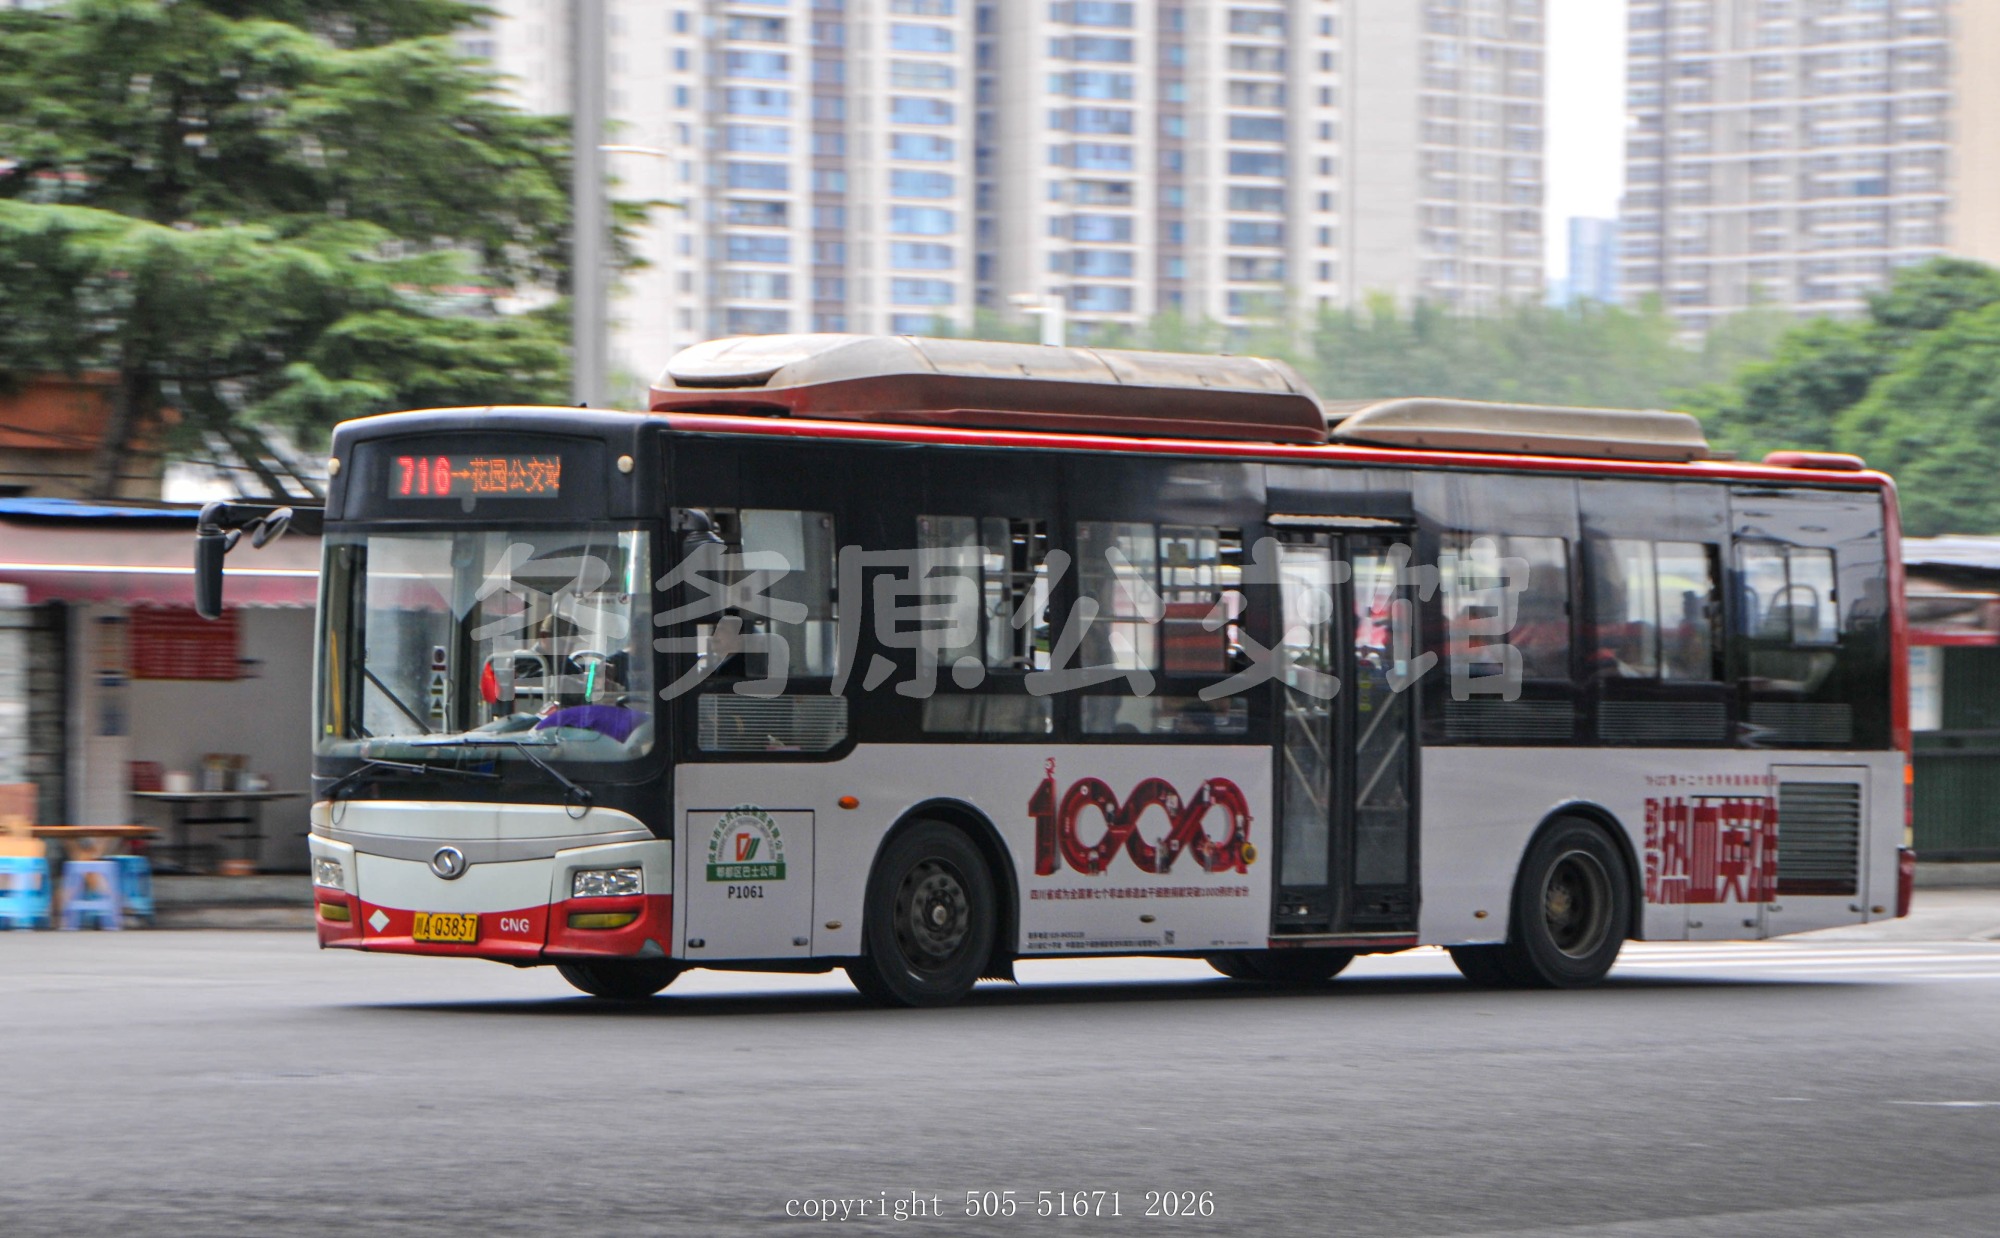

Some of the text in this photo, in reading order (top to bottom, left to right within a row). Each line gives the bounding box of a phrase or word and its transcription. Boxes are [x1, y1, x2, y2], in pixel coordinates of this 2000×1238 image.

[397, 456, 561, 496] 716 花园公交站
[728, 885, 764, 899] P1061
[500, 917, 530, 933] CNG
